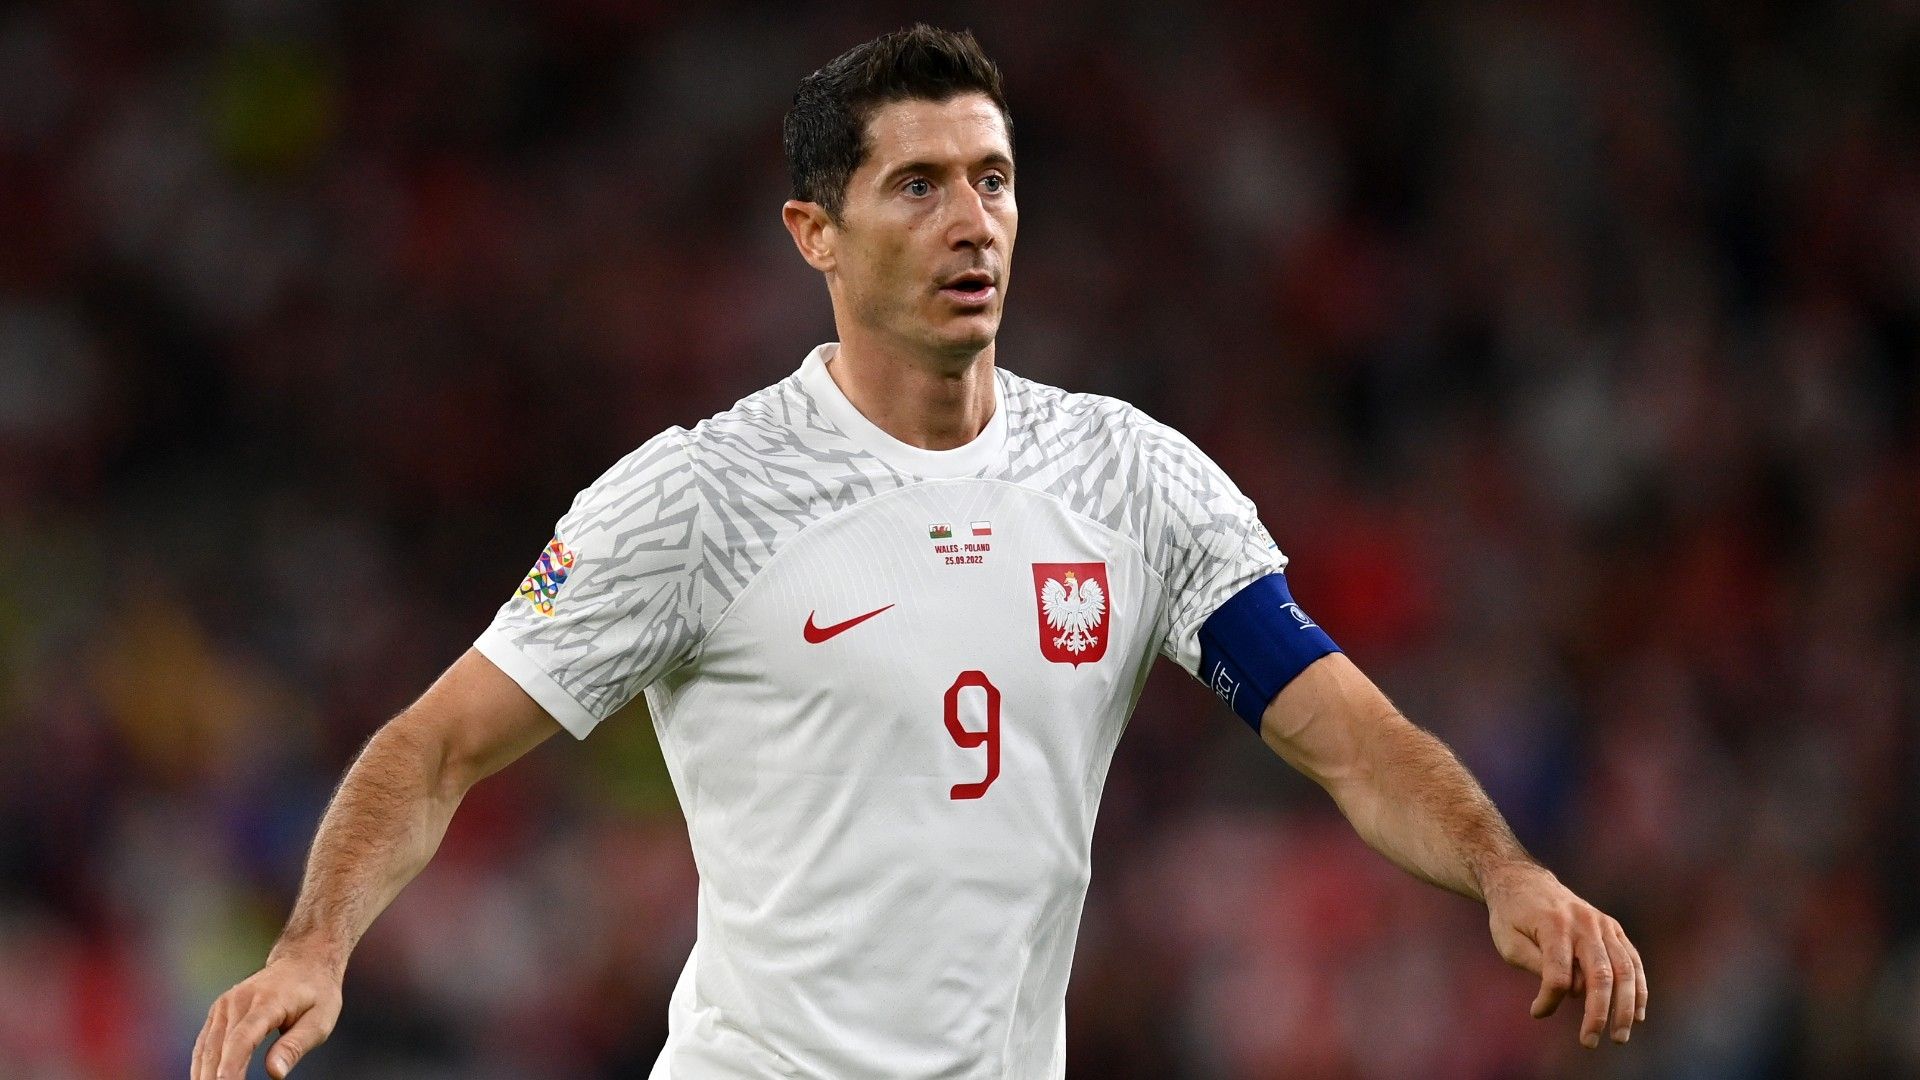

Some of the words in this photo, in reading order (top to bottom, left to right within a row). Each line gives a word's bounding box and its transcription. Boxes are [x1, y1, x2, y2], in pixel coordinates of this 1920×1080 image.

[935, 544, 959, 553] WALES
[964, 543, 990, 552] POLAND
[945, 555, 983, 565] 25.09.2022
[1215, 667, 1233, 701] ECT
[943, 670, 1001, 800] 9
